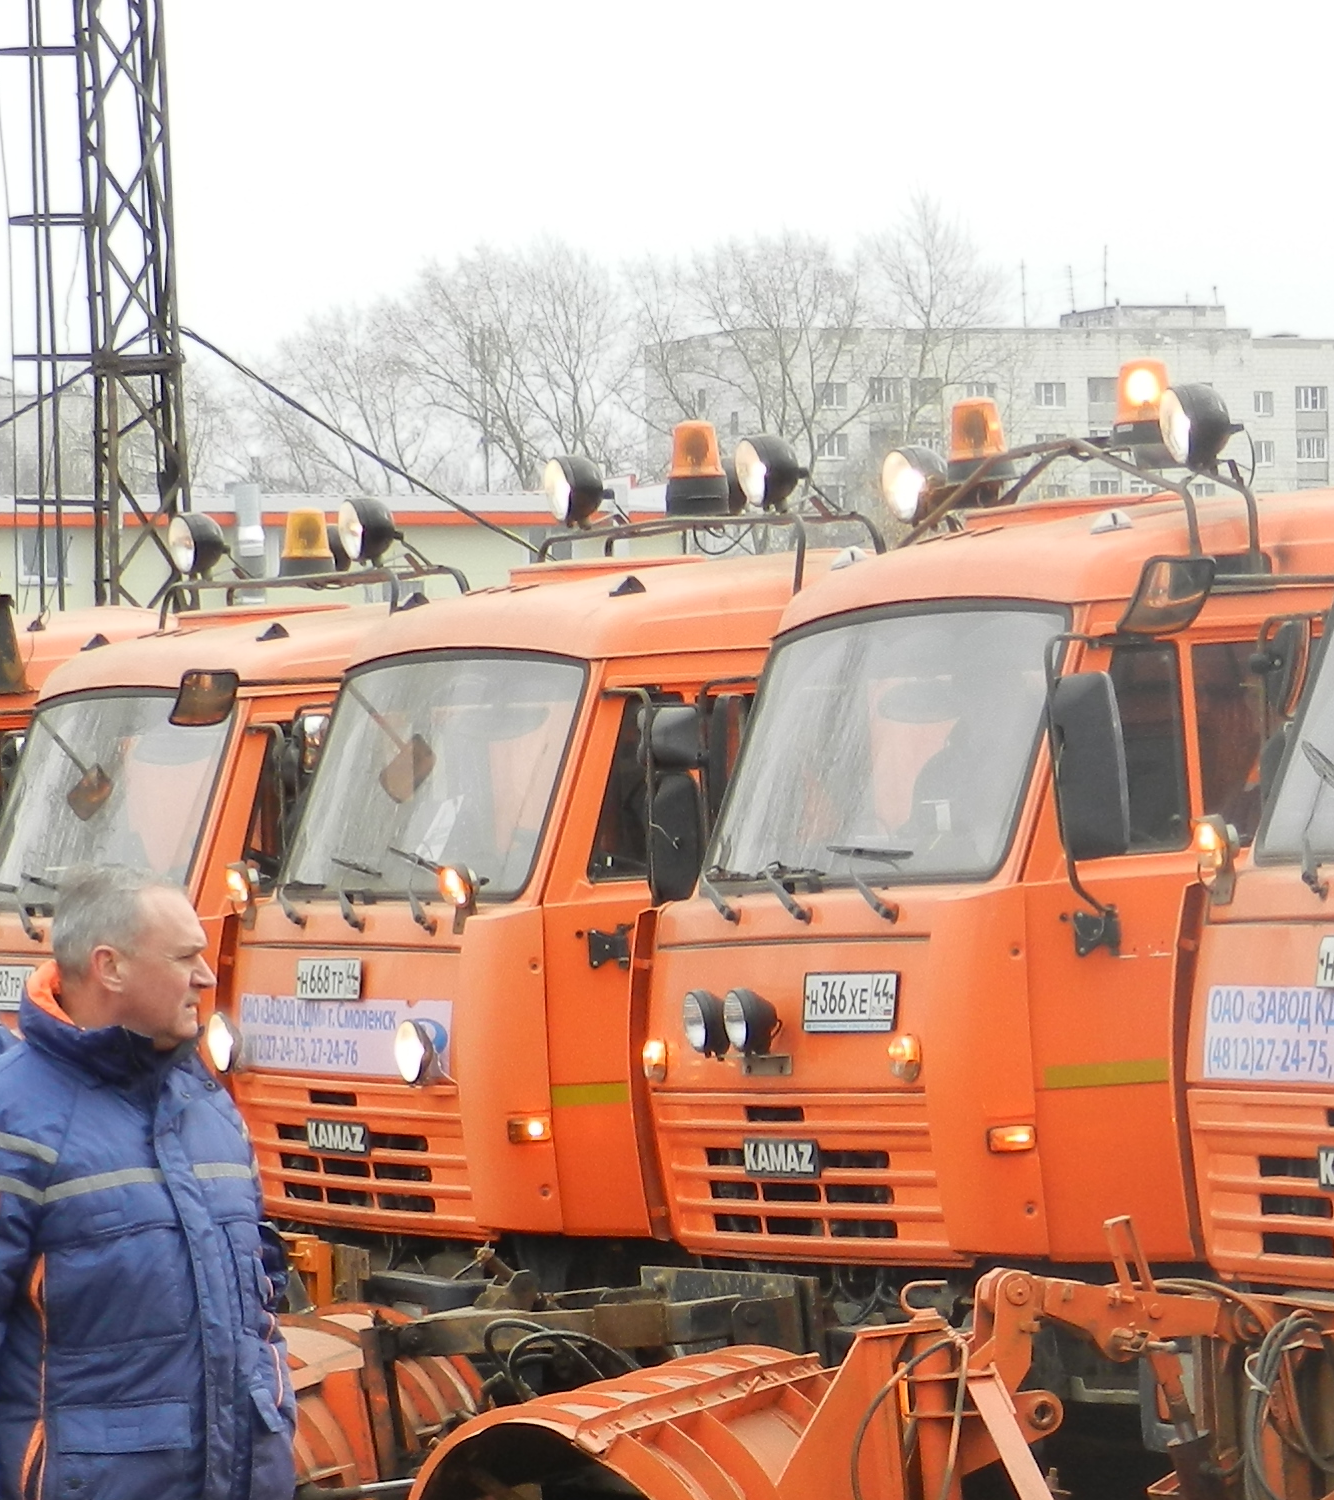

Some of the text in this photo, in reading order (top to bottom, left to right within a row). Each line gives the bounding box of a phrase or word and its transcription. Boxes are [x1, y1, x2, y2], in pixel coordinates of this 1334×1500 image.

[874, 978, 889, 1005] 44
[337, 1001, 397, 1031] Смоленск
[1211, 989, 1245, 1024] ОАО
[1247, 990, 1312, 1034] «ЗАВОД
[310, 1038, 359, 1066] 27-24-76
[1208, 1035, 1334, 1079] (4812)27-24-75,
[307, 1121, 366, 1153] KAMAZ
[743, 1142, 815, 1173] KAMAZ
